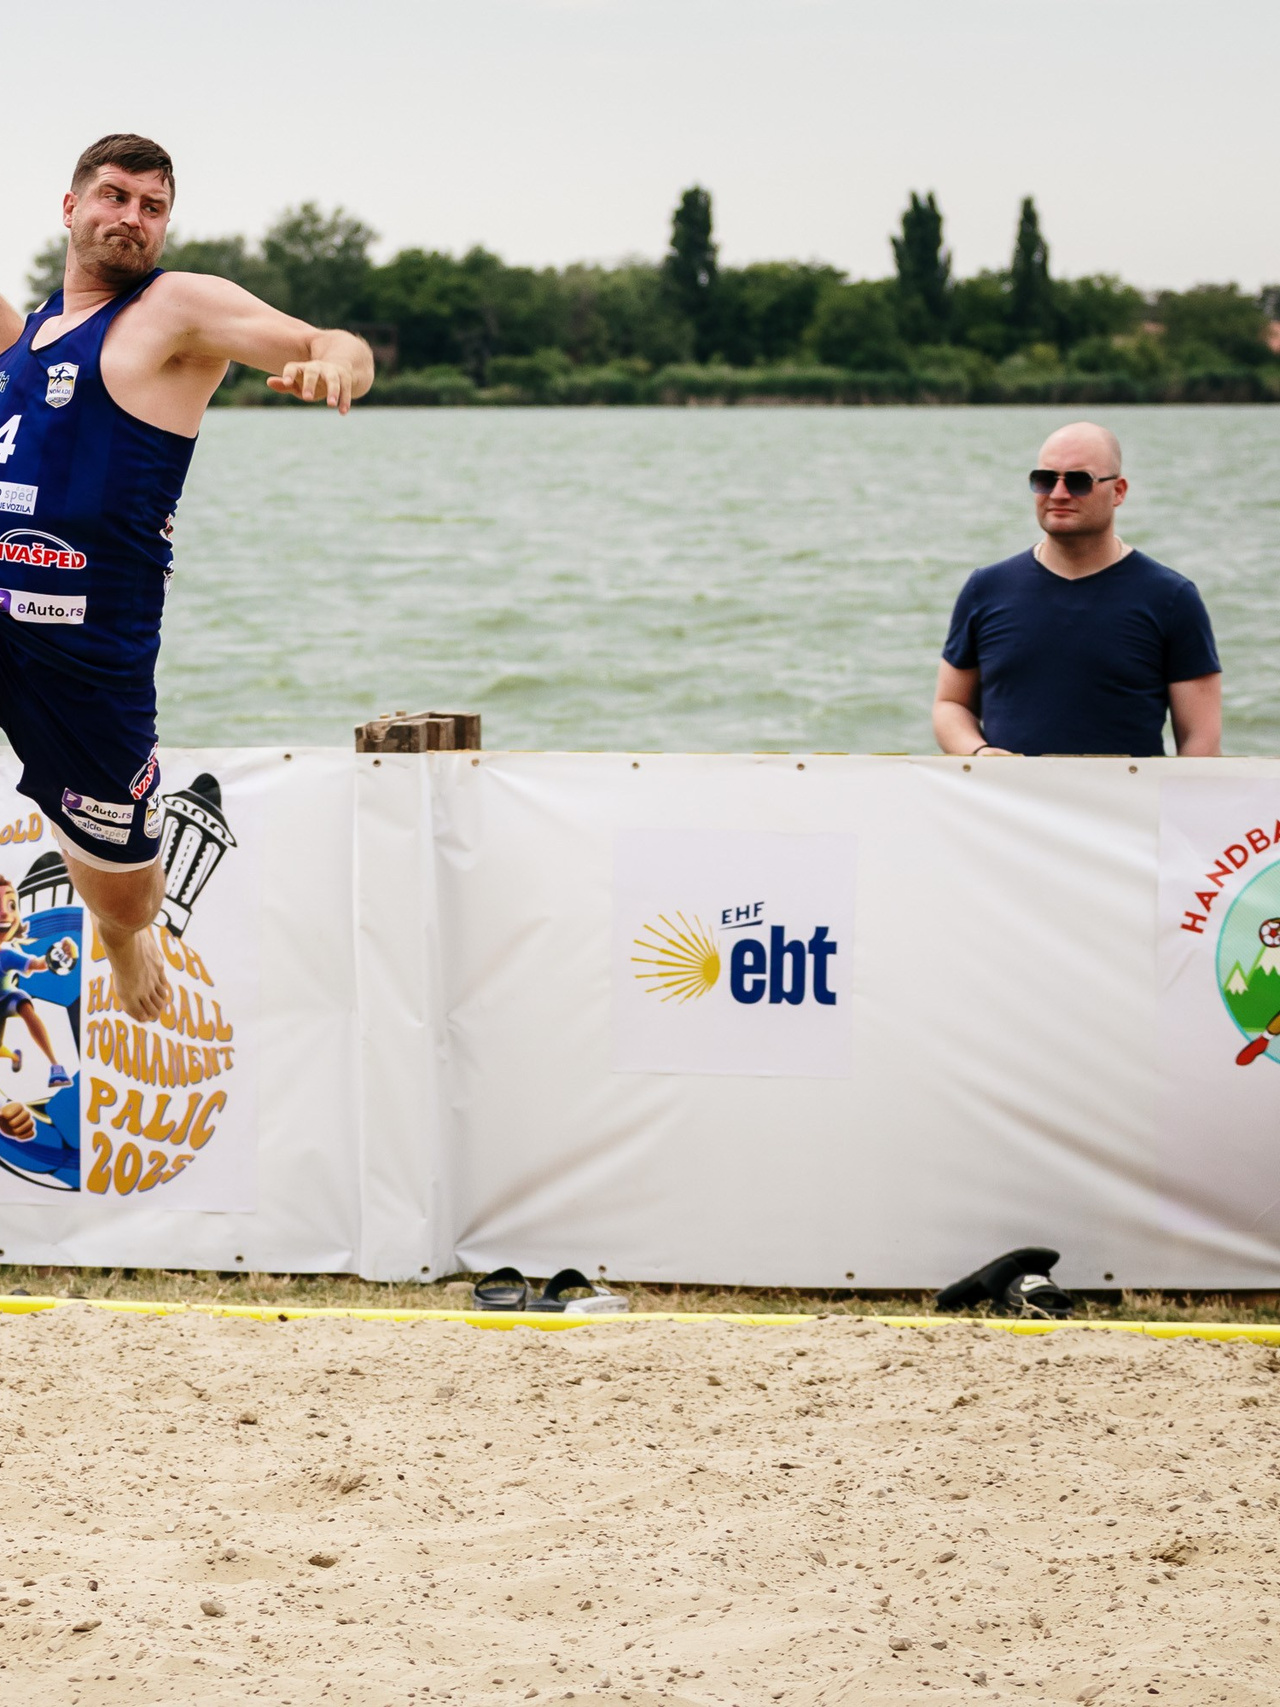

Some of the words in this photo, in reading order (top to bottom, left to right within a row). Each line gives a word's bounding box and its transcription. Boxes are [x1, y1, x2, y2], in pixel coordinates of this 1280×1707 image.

[4, 489, 35, 503] sped
[6, 503, 31, 513] VOZILA
[17, 601, 84, 617] eAuto.rs
[85, 804, 132, 819] eAuto.rs
[1180, 819, 1280, 934] HANDB
[721, 901, 765, 925] EHF
[730, 925, 837, 1006] ebt
[87, 972, 233, 1042] HABALL
[86, 1018, 235, 1089] TORNAMENT
[86, 1076, 228, 1151] PALIC
[86, 1131, 196, 1196] 2025
